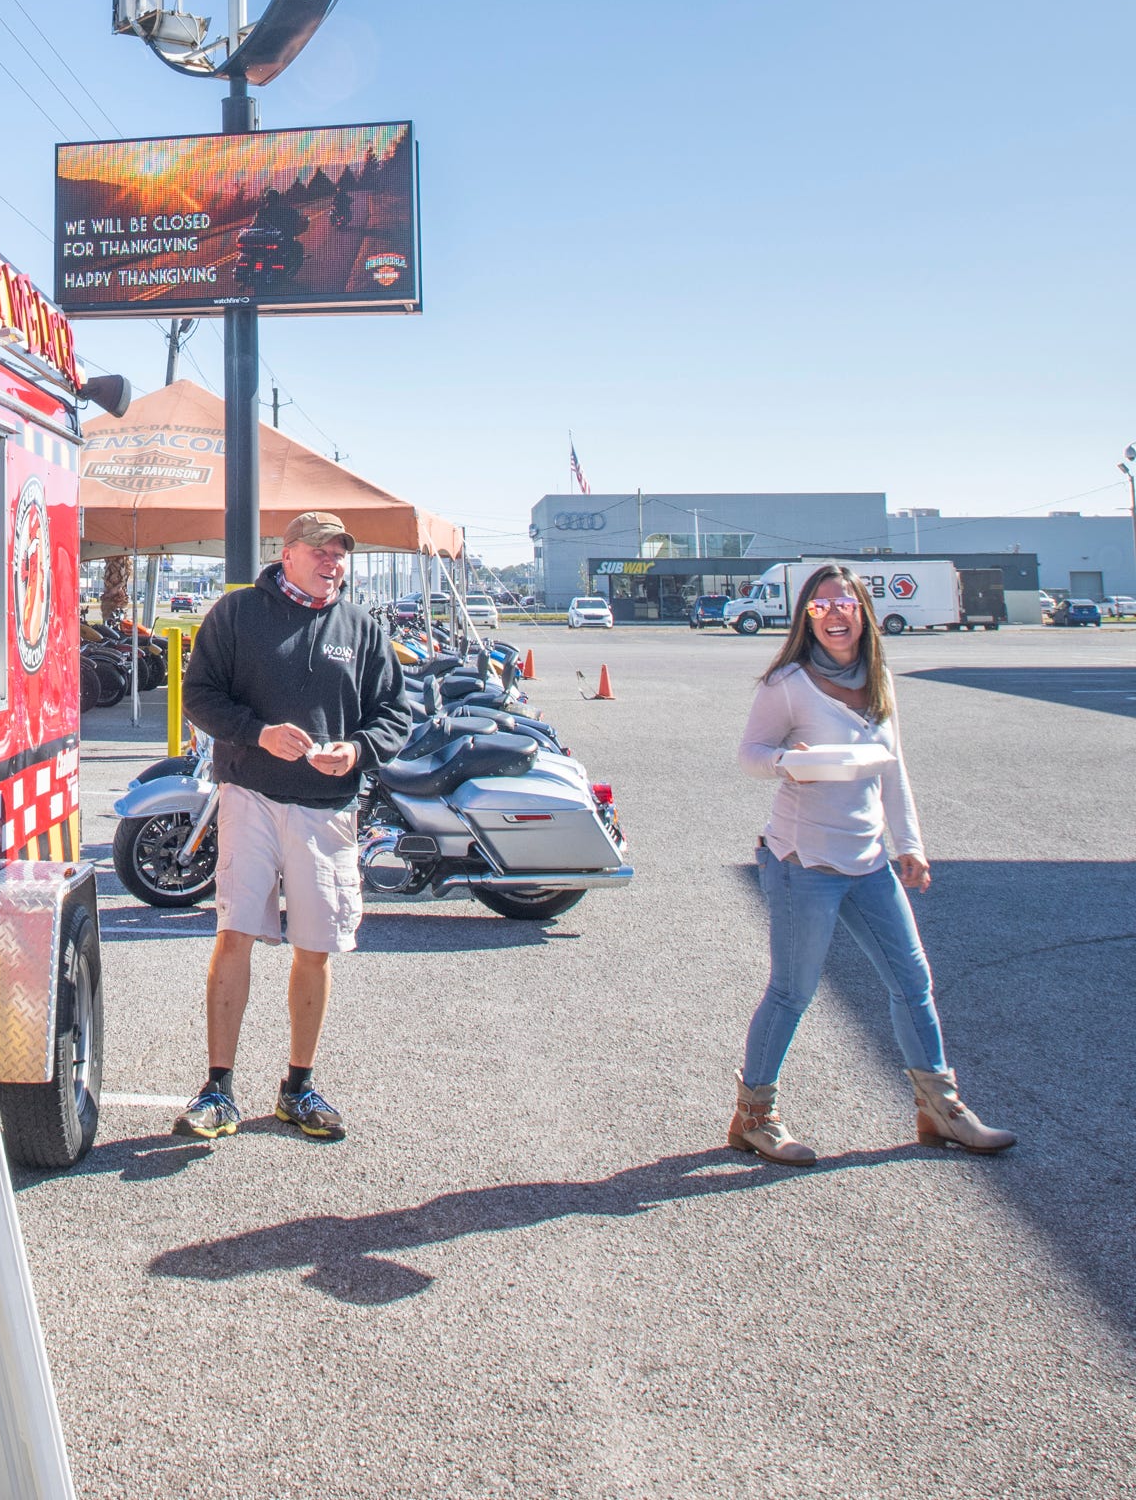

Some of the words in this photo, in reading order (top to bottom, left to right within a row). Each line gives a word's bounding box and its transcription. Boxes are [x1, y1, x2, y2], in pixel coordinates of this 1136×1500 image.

[64, 219, 86, 236] WE
[91, 216, 125, 234] WILL
[130, 215, 147, 232] BE
[152, 212, 211, 231] CLOSED
[63, 240, 94, 257] FOR
[99, 236, 198, 256] THANKGIVING
[64, 271, 111, 288] HAPPY
[117, 266, 217, 285] THANKGIVING
[86, 424, 225, 437] ARLEY-DAVIDSO
[83, 433, 225, 455] ENSACOL
[94, 465, 201, 480] HARLEY-DAVIDSON
[596, 561, 656, 574] SUBWAY
